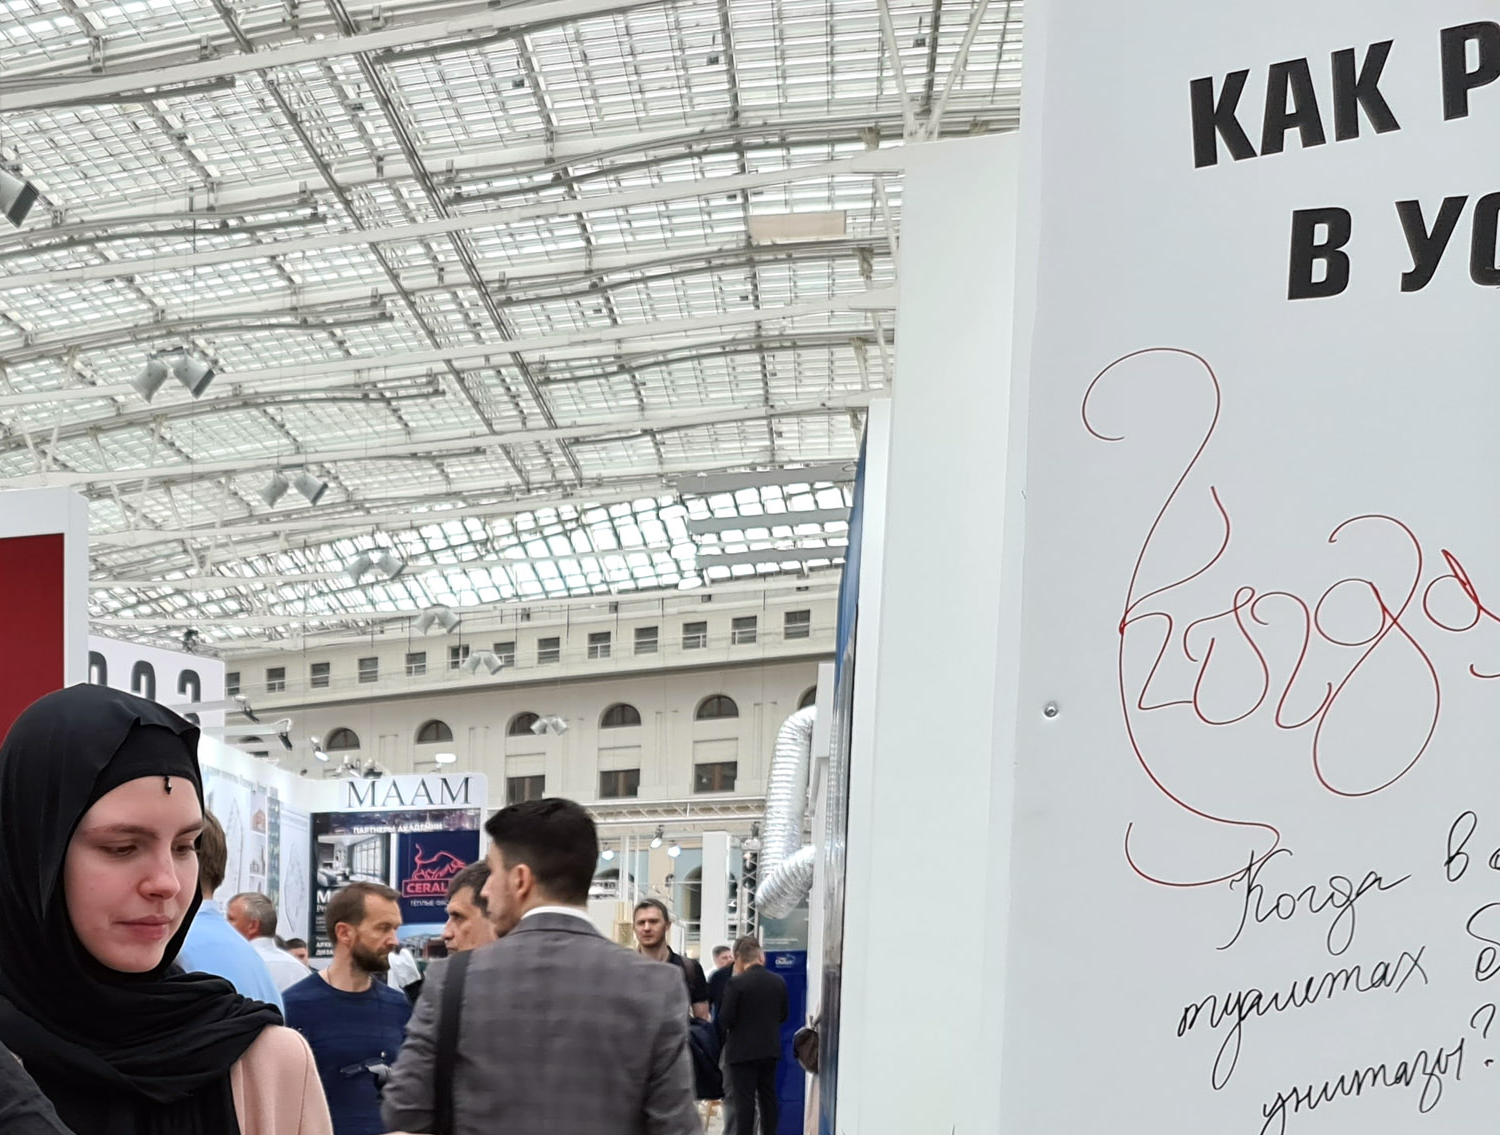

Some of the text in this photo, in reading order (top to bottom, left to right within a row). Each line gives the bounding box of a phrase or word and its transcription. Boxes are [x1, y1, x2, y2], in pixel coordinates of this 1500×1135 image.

[1189, 38, 1402, 169] КАК
[1287, 206, 1352, 301] В
[1216, 847, 1412, 956] Когда
